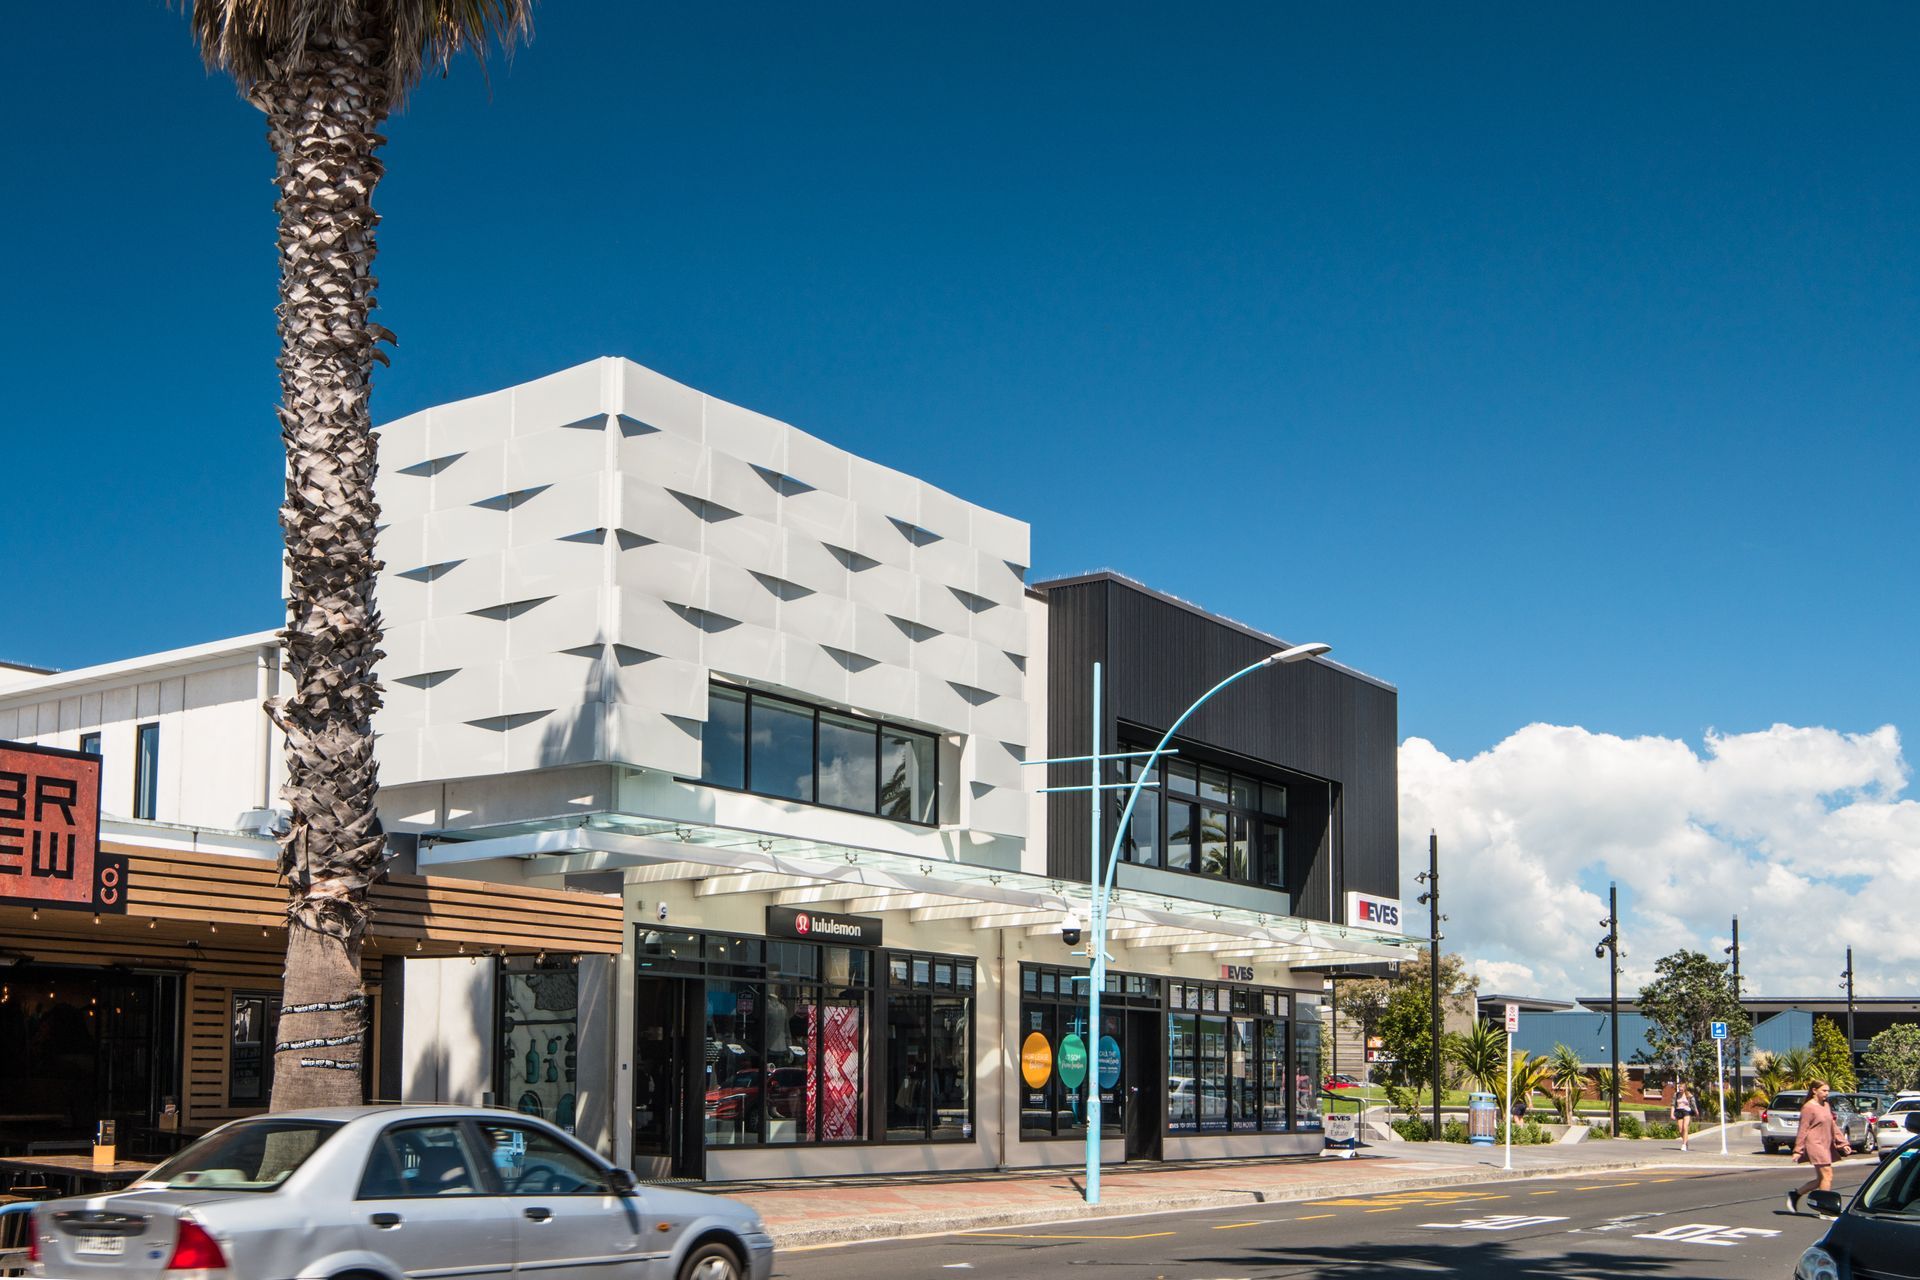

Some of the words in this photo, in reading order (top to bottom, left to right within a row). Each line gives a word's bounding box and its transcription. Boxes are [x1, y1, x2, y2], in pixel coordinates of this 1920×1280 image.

[1367, 902, 1399, 926] EVES
[811, 917, 862, 937] lululemon
[1228, 965, 1254, 981] EVES
